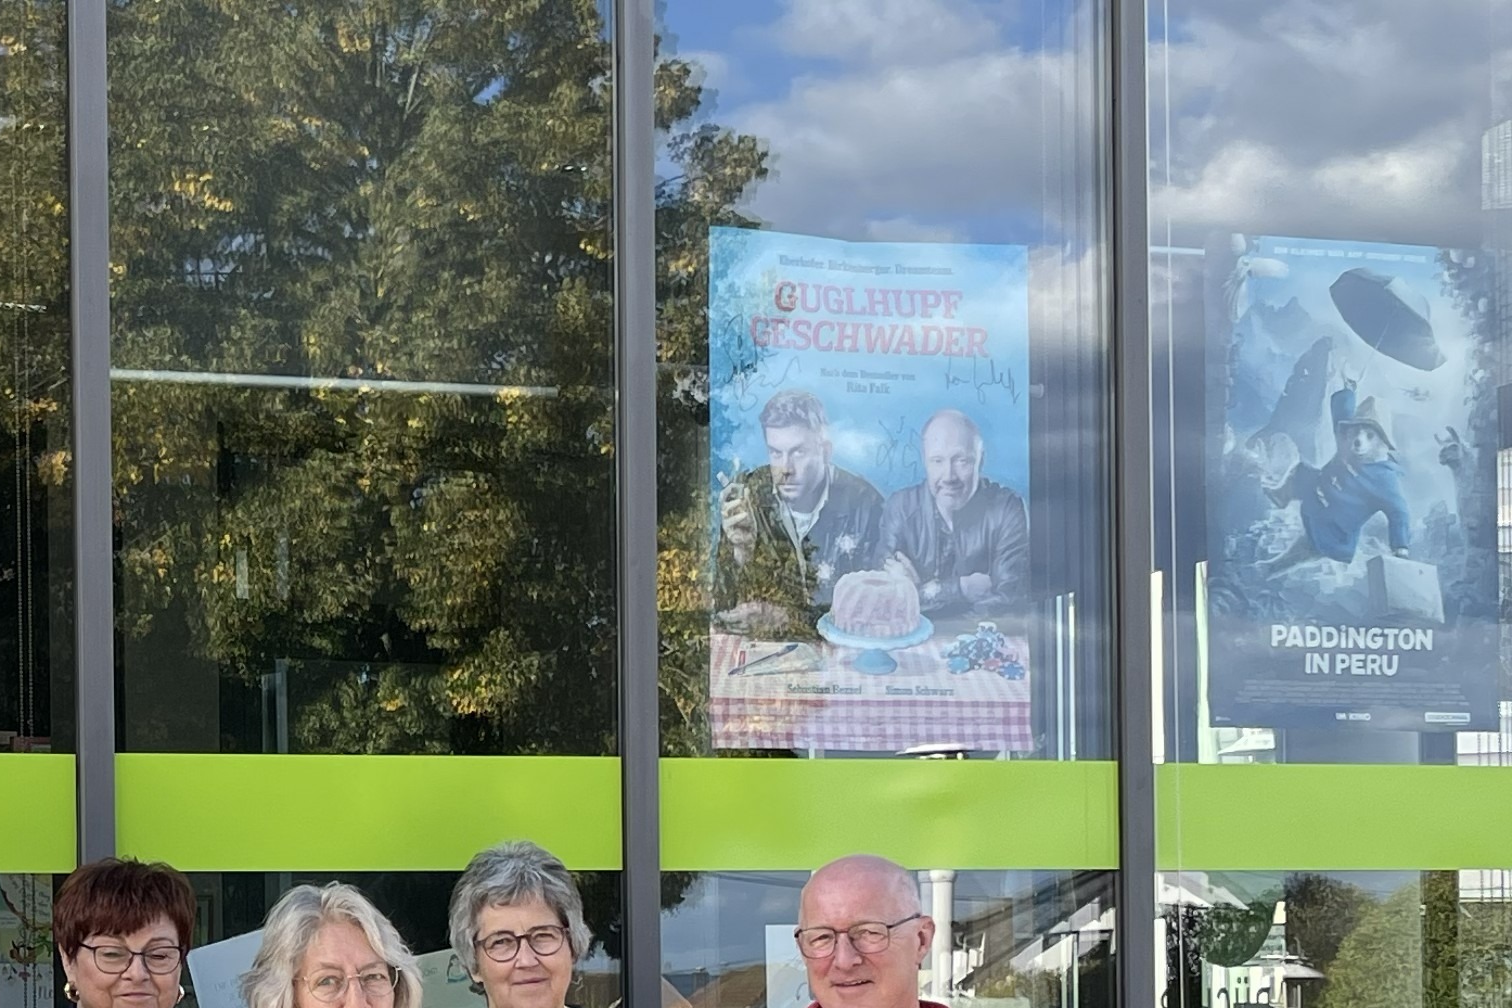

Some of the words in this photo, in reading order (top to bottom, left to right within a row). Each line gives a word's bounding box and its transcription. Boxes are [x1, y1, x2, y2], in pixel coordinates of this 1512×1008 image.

[774, 281, 964, 319] GUGLHUPF
[750, 315, 990, 358] GESCHWADER
[1304, 652, 1330, 674] IN
[1334, 653, 1400, 677] PERU
